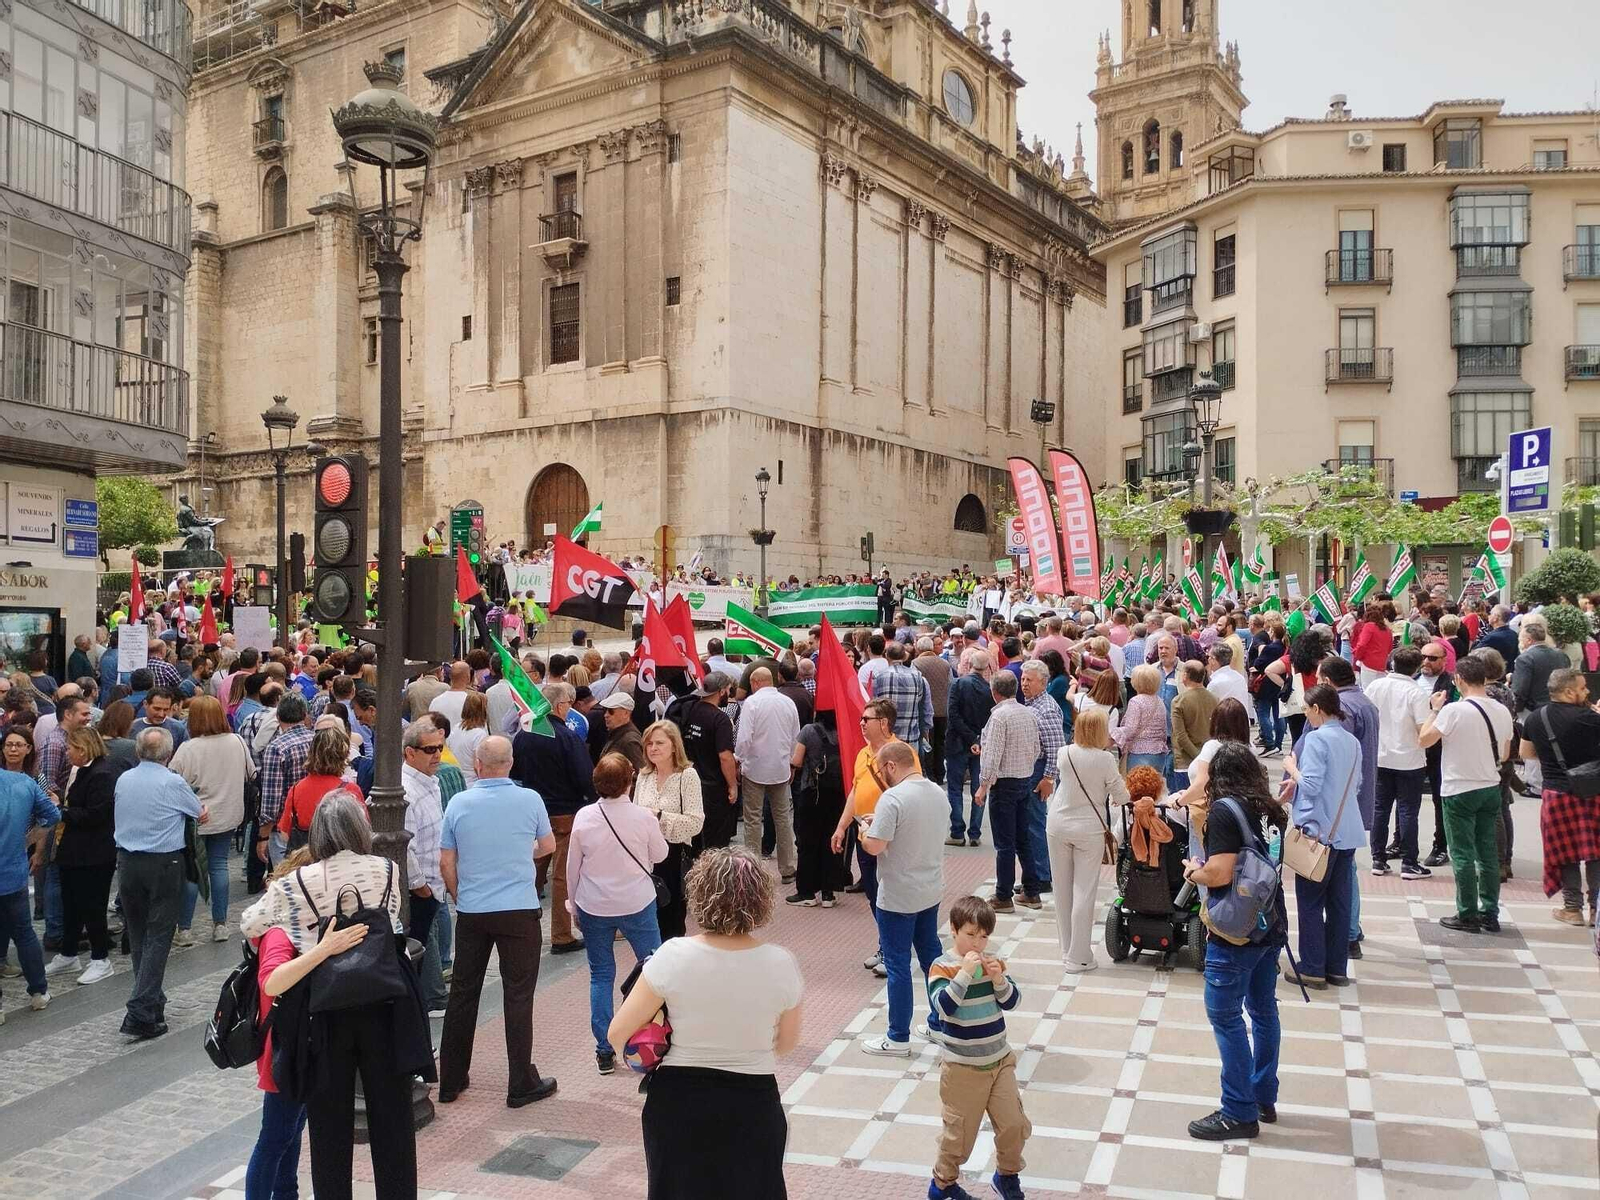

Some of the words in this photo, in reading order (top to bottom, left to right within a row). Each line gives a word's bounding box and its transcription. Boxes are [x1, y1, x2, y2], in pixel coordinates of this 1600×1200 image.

[1522, 434, 1540, 467] P
[17, 492, 53, 501] SOUVENIRS
[17, 508, 53, 517] MINERALES
[20, 525, 50, 533] REGALOS
[567, 564, 624, 604] CGT
